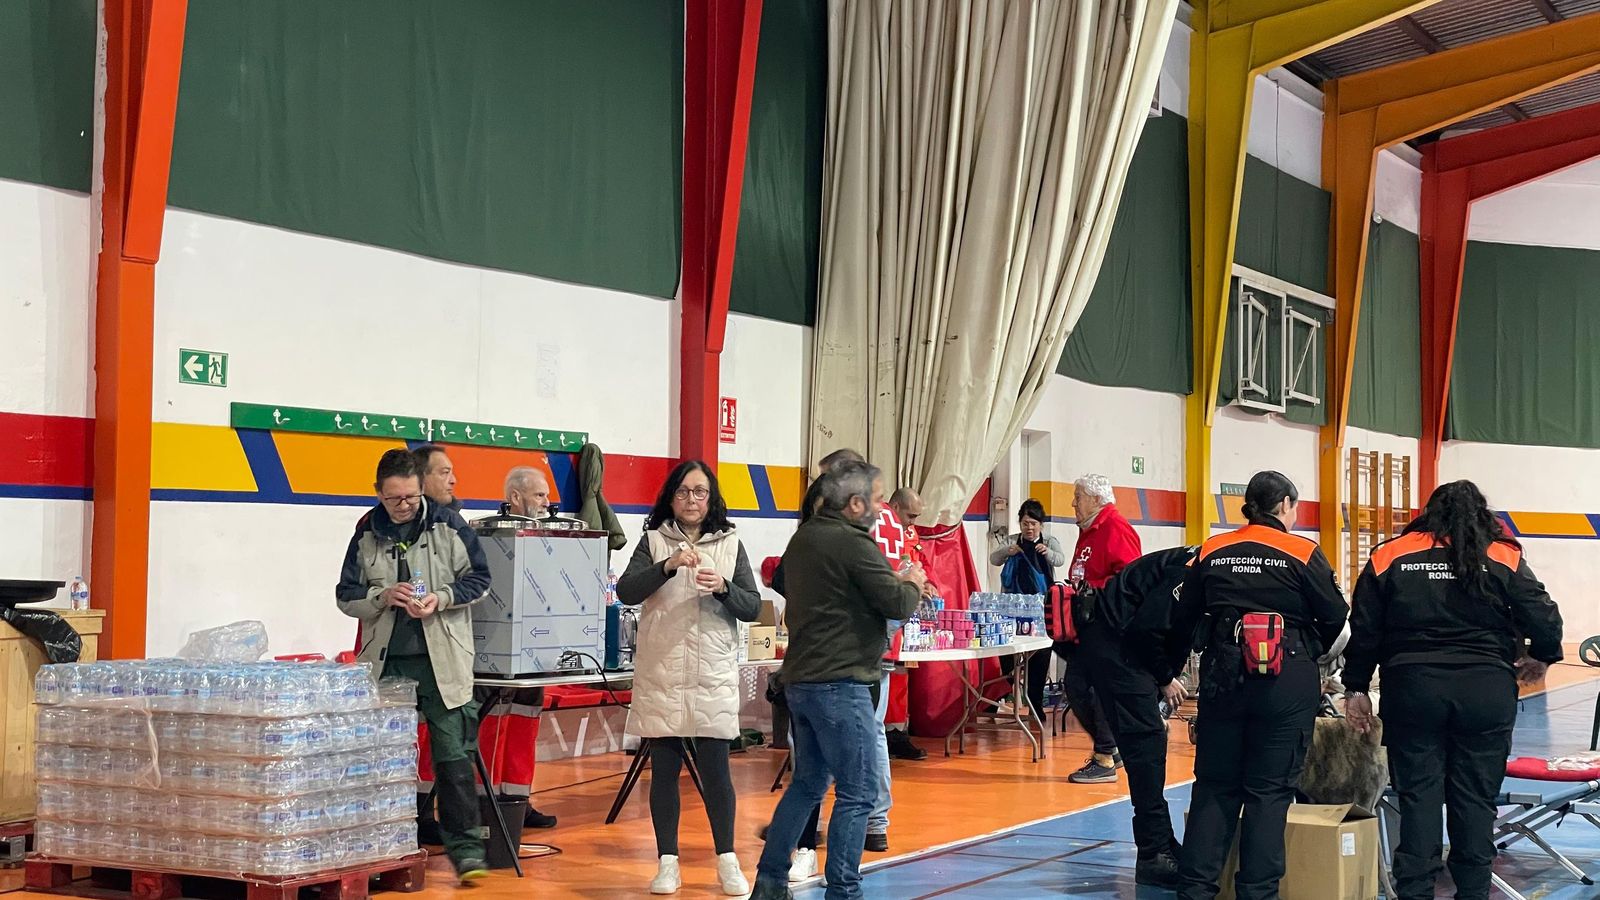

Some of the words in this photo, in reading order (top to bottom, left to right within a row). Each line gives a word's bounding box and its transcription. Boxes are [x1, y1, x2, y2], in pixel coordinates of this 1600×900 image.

[1210, 556, 1263, 567] PROTECCIÓN
[1264, 558, 1288, 568] CIVIL
[1401, 562, 1454, 571] PROTECCI
[1232, 565, 1262, 574] RONDA
[1428, 571, 1457, 580] RON
